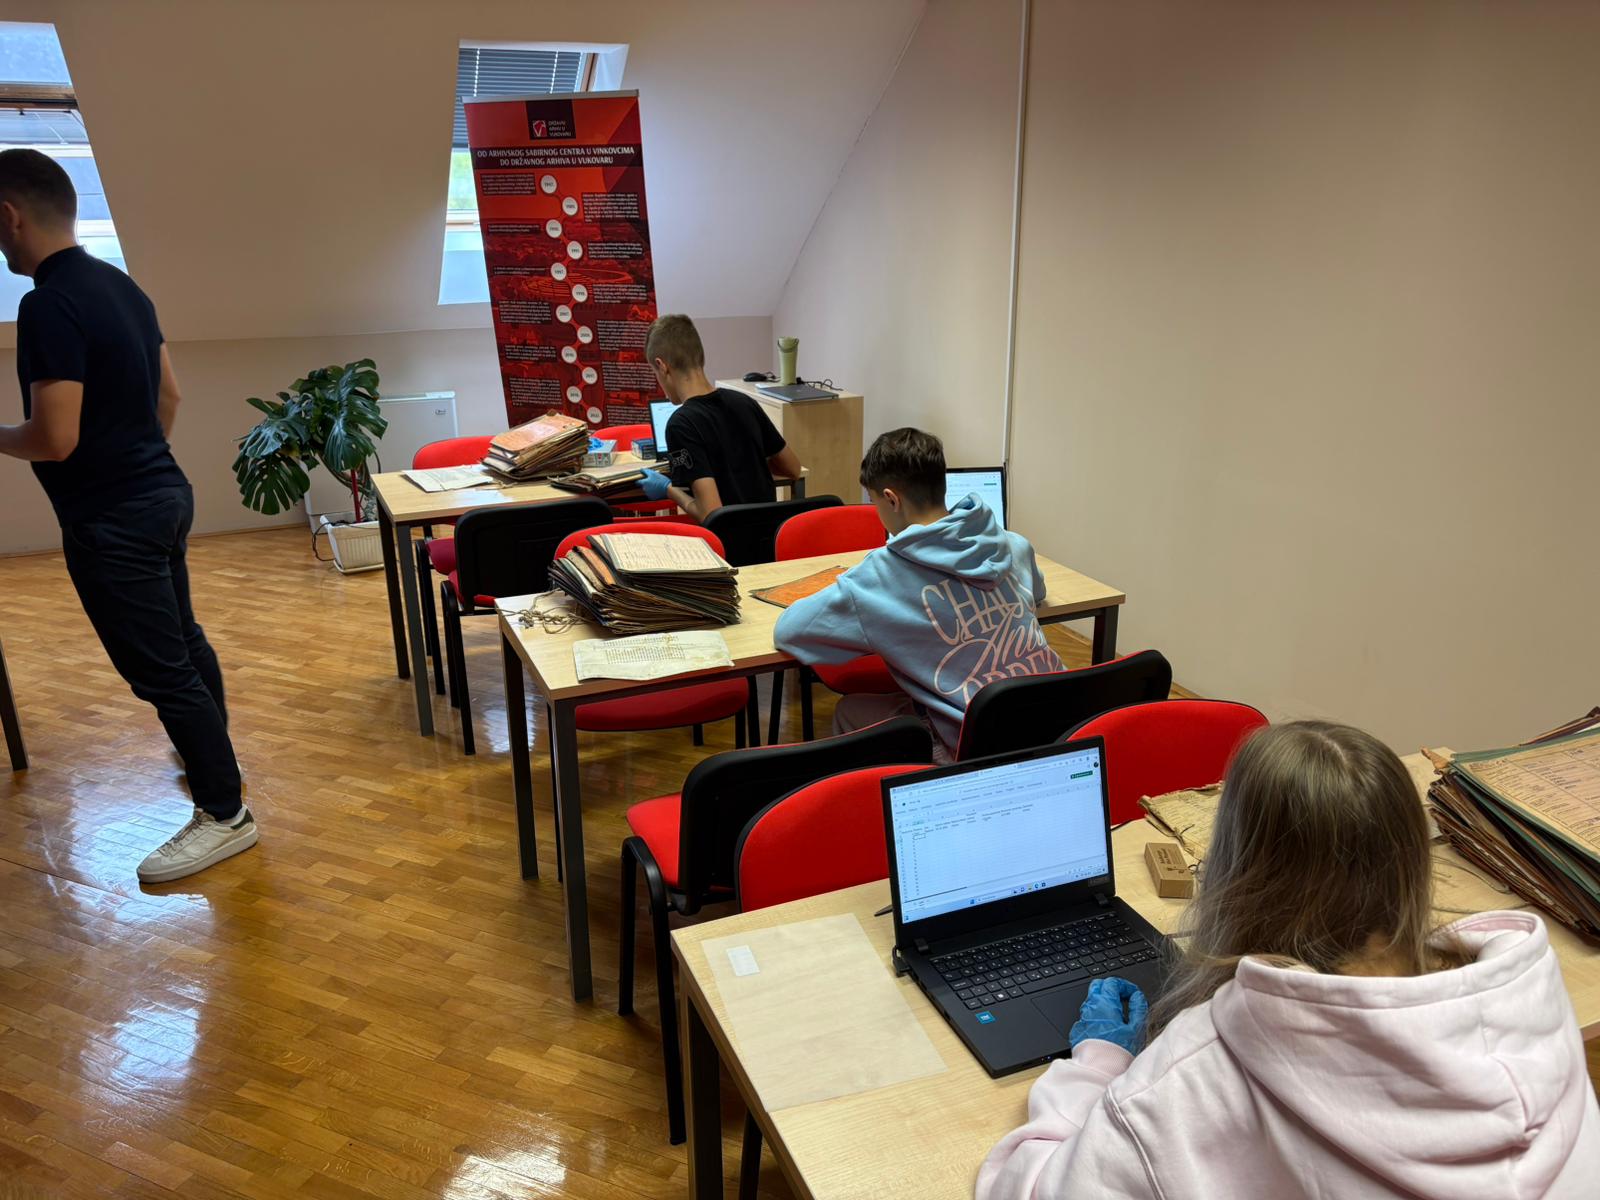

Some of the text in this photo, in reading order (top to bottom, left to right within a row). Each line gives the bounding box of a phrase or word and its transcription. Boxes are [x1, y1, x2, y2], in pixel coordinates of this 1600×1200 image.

[526, 148, 558, 156] SABIRNOG
[592, 146, 635, 154] VINKOVCIMA
[510, 156, 545, 166] DRŽAVNOG
[577, 156, 614, 164] VUKOVARU
